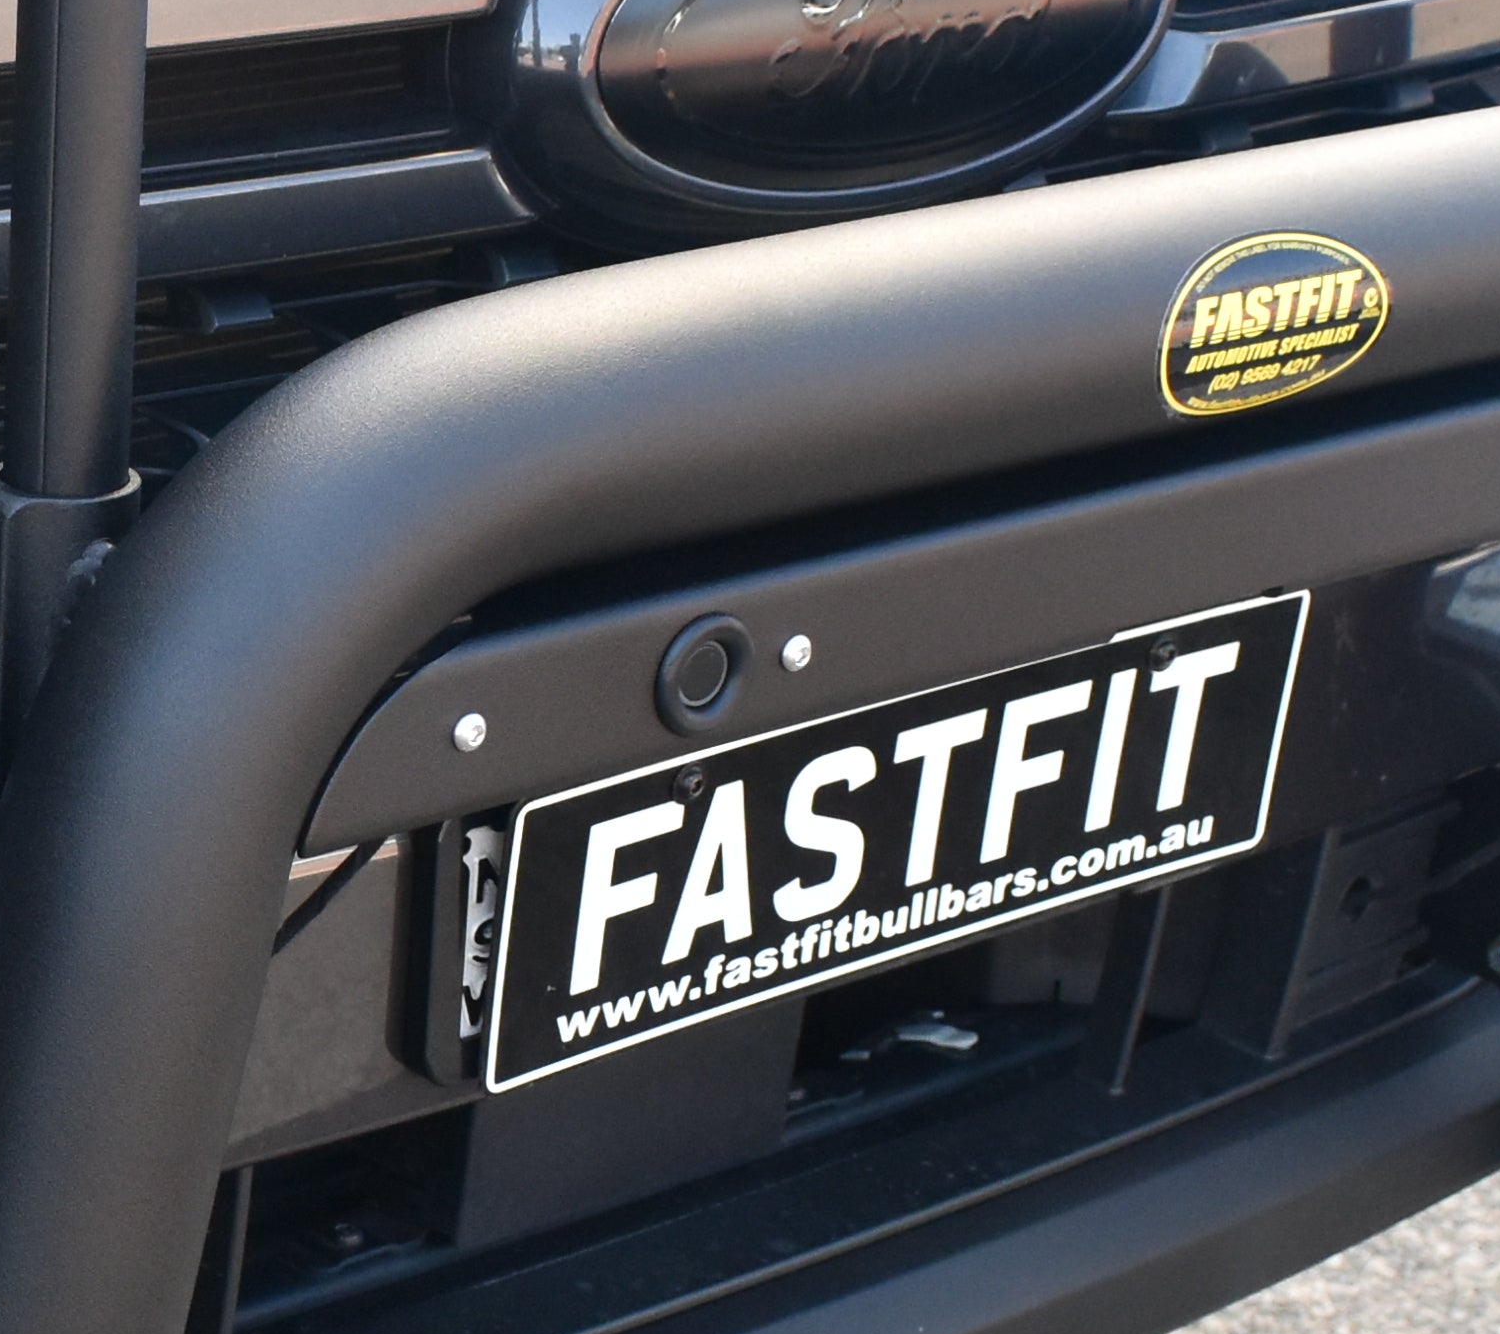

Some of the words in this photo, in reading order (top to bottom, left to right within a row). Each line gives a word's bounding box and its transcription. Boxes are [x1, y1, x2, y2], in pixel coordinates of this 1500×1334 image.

[1184, 339, 1279, 375] AUTOMOTIVE
[1278, 323, 1360, 355] SPECIALIST
[1190, 269, 1362, 349] FASTFIT
[1208, 370, 1240, 395] (02)
[1281, 354, 1322, 377] 4217
[569, 641, 1241, 996] FASTFIT
[556, 815, 1214, 1043] www.fastfitbullbars.com.au
